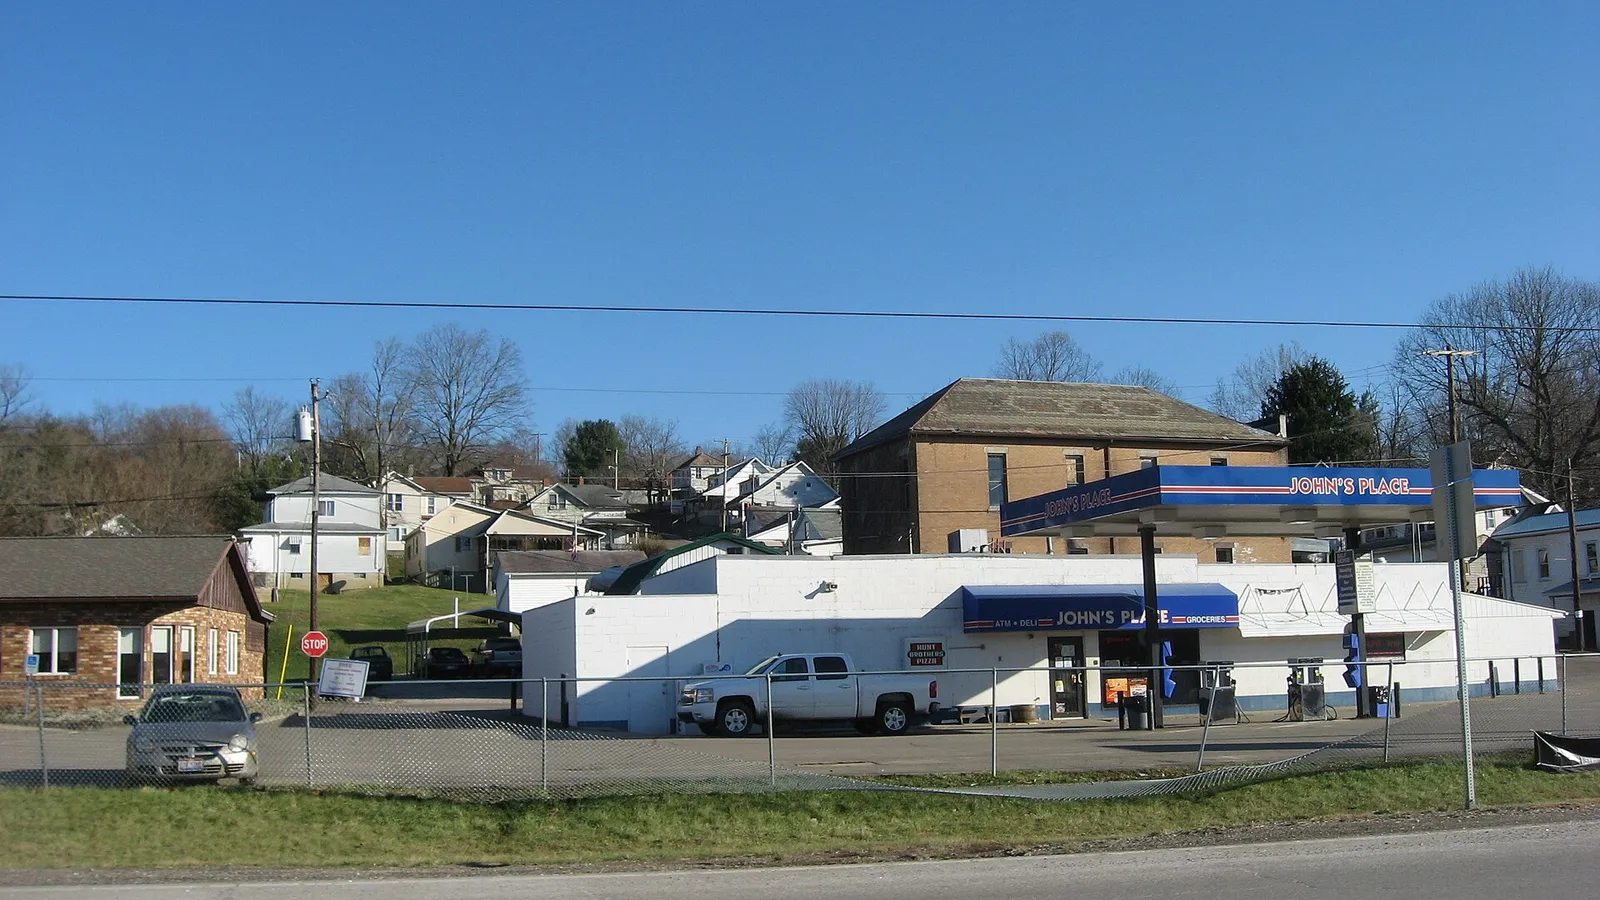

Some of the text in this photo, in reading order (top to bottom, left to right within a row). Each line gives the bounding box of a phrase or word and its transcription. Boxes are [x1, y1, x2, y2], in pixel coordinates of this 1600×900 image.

[1289, 476, 1410, 496] JOHN'S PLACE
[1044, 488, 1111, 518] JOHN'S PLACE
[995, 619, 1038, 628] ATM DELI
[1057, 609, 1169, 626] JOHN'S PLAE
[1186, 615, 1226, 624] GROCERIES
[303, 639, 326, 650] STOP
